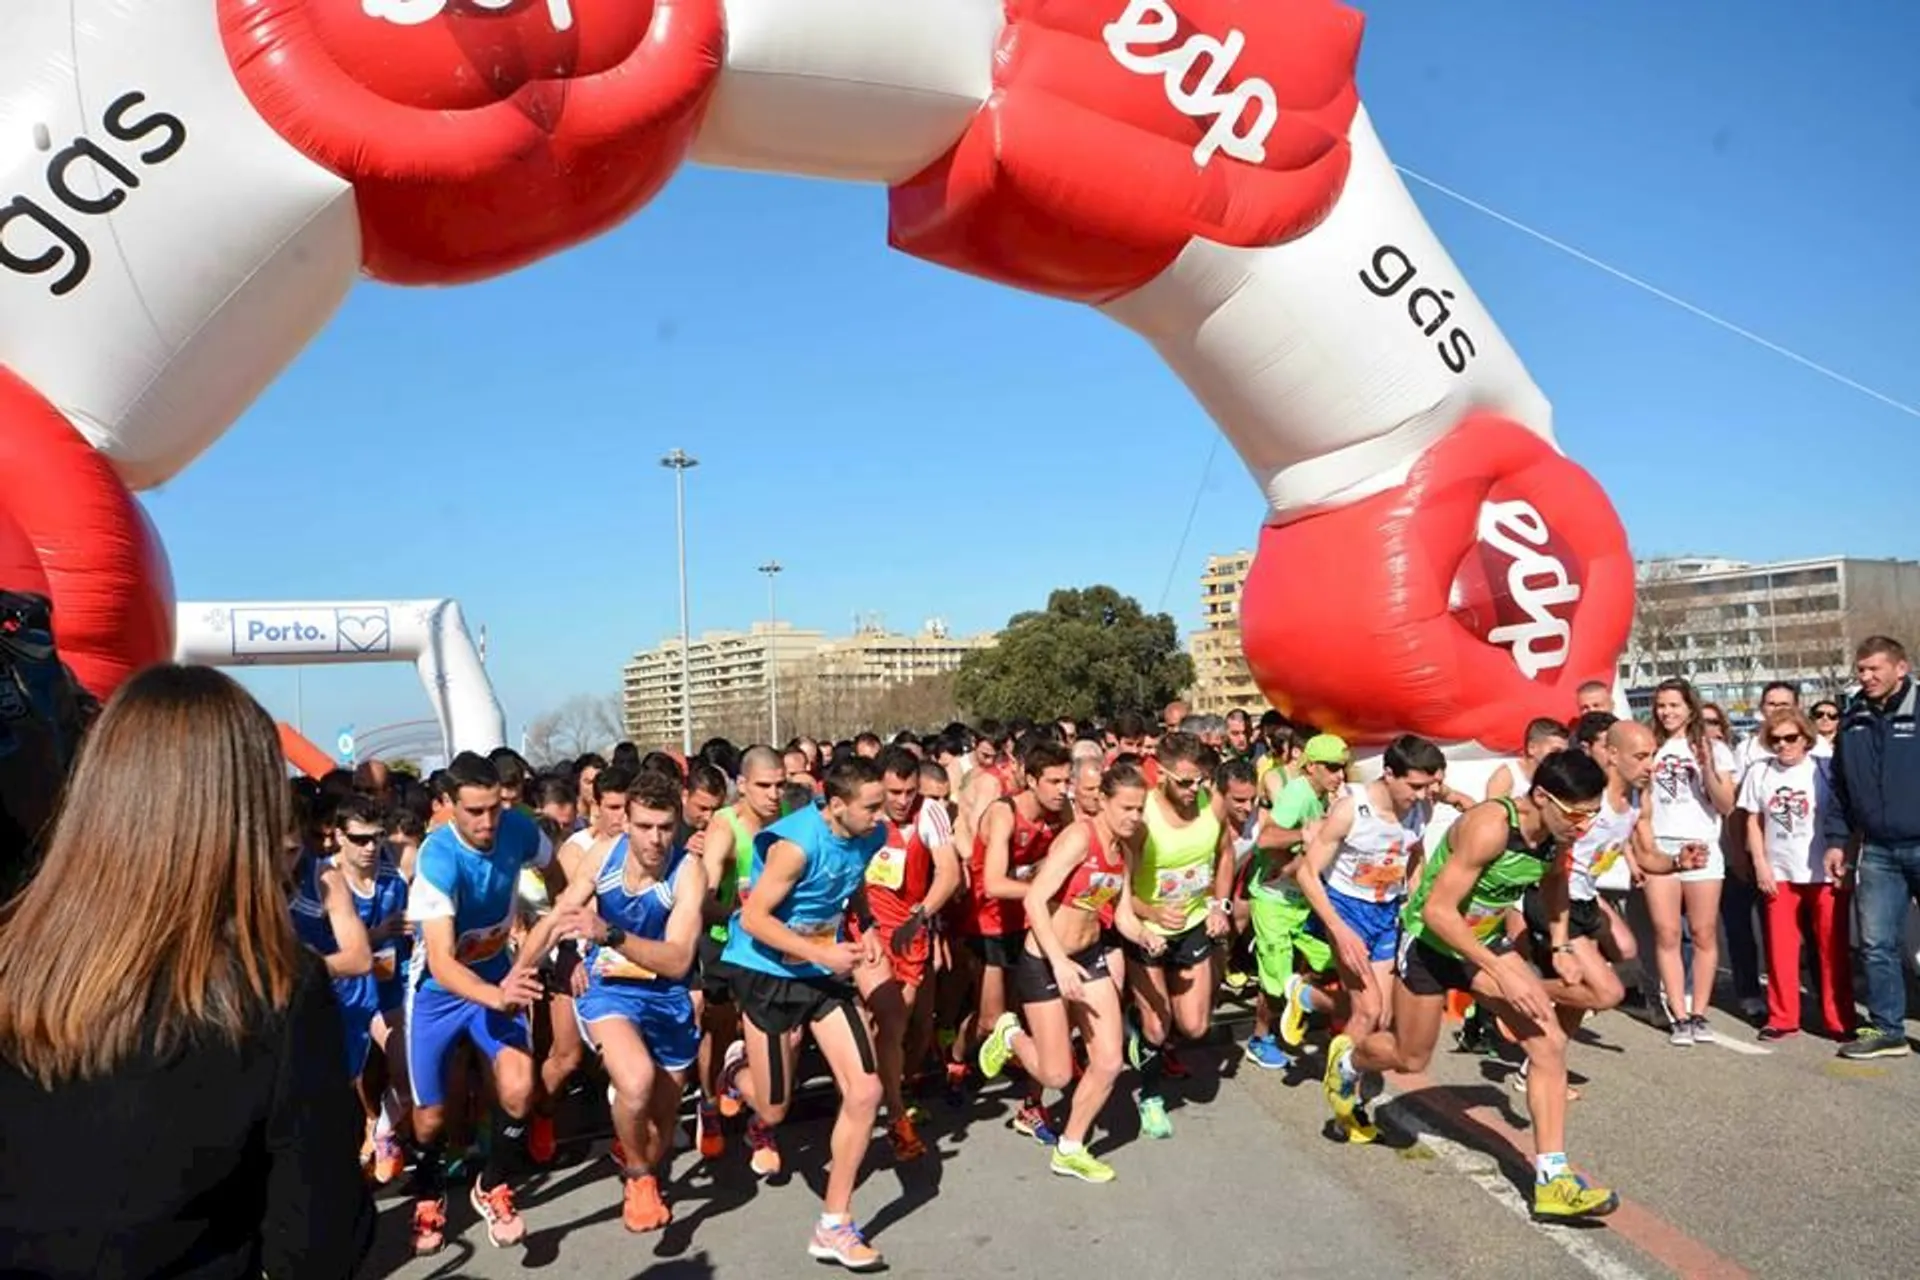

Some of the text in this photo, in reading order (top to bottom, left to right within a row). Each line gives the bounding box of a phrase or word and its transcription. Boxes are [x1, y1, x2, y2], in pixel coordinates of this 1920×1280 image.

[1103, 0, 1278, 168] edp
[1358, 244, 1476, 374] gás
[247, 620, 327, 641] Porto.
[1477, 499, 1581, 680] edp
